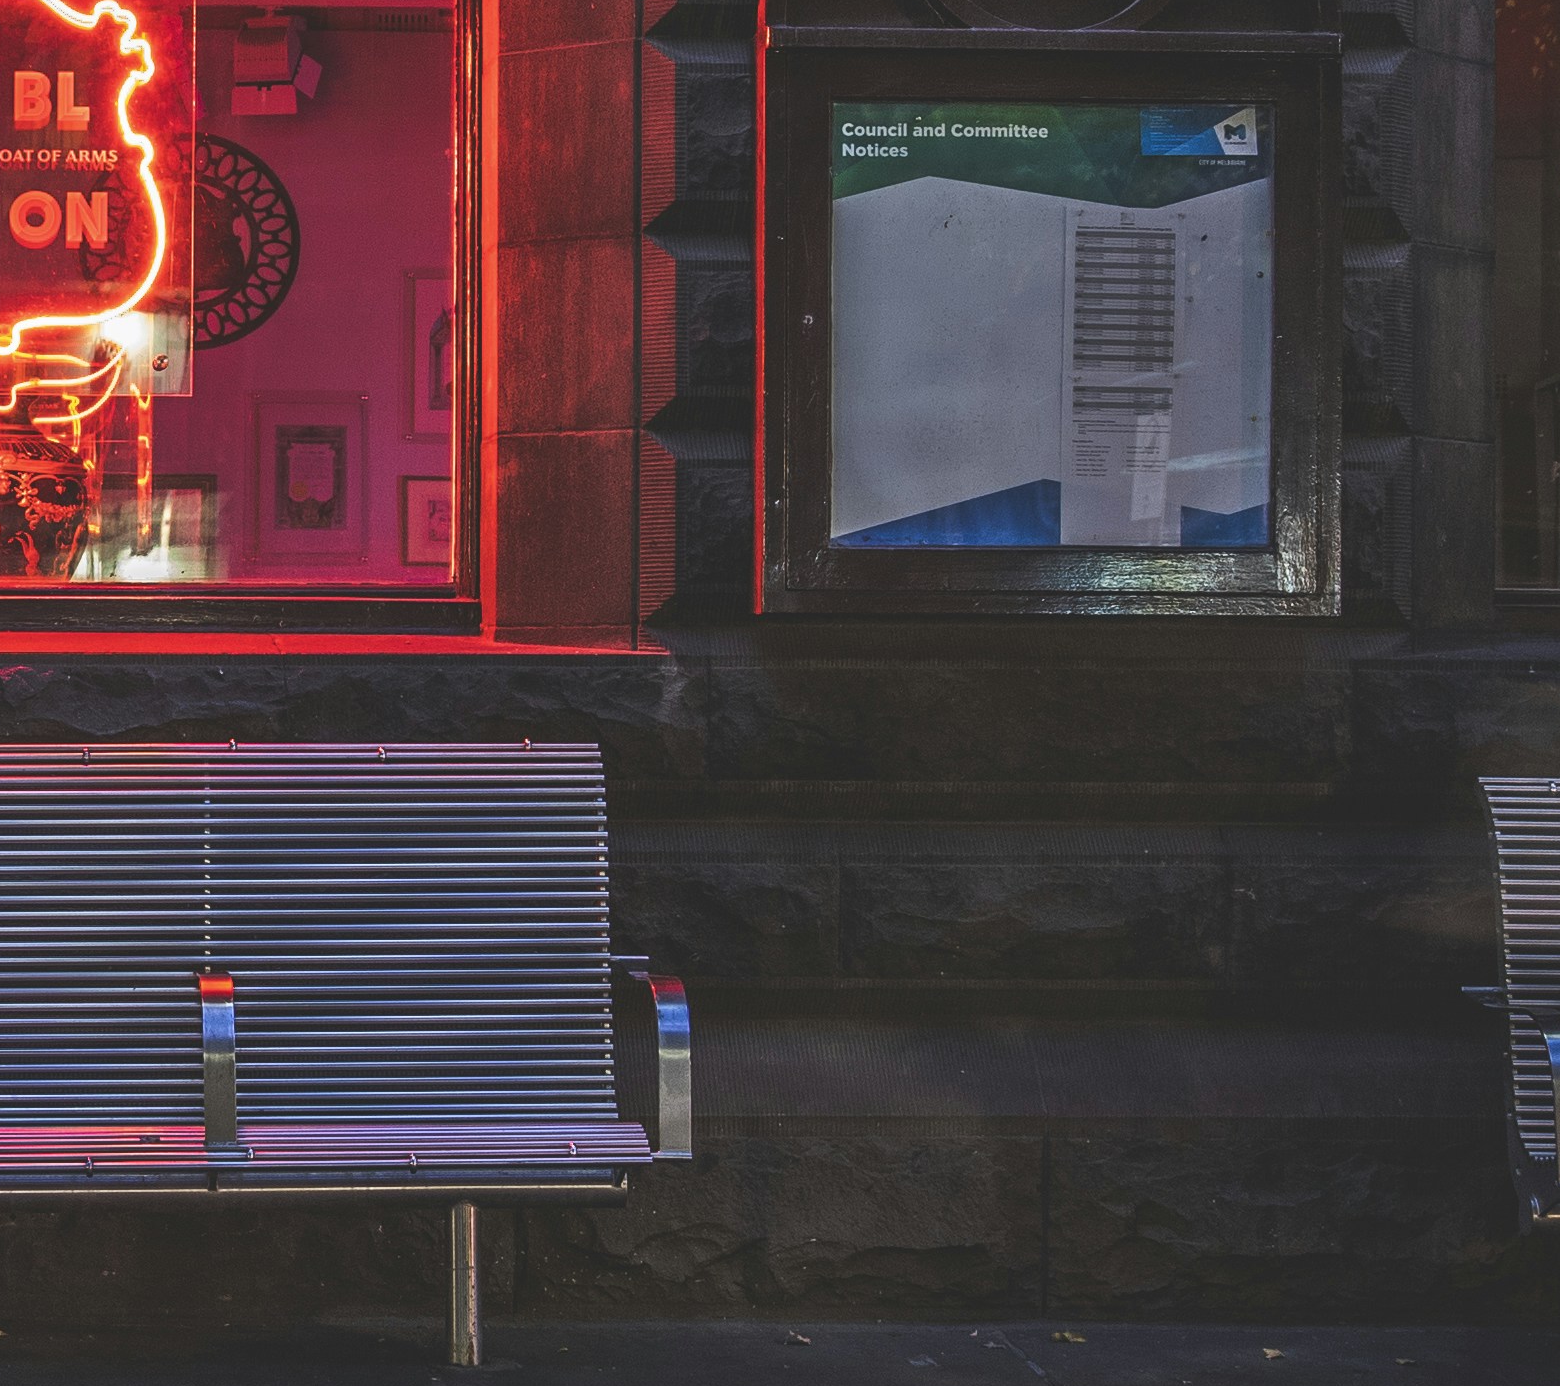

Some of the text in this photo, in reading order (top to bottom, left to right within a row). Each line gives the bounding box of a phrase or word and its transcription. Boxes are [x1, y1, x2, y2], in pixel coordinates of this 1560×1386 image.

[14, 71, 90, 125] BL
[842, 123, 1049, 139] Council and Committee
[38, 149, 61, 163] OF
[66, 149, 118, 163] ARMS
[842, 143, 908, 157] Notices
[9, 190, 108, 246] ON
